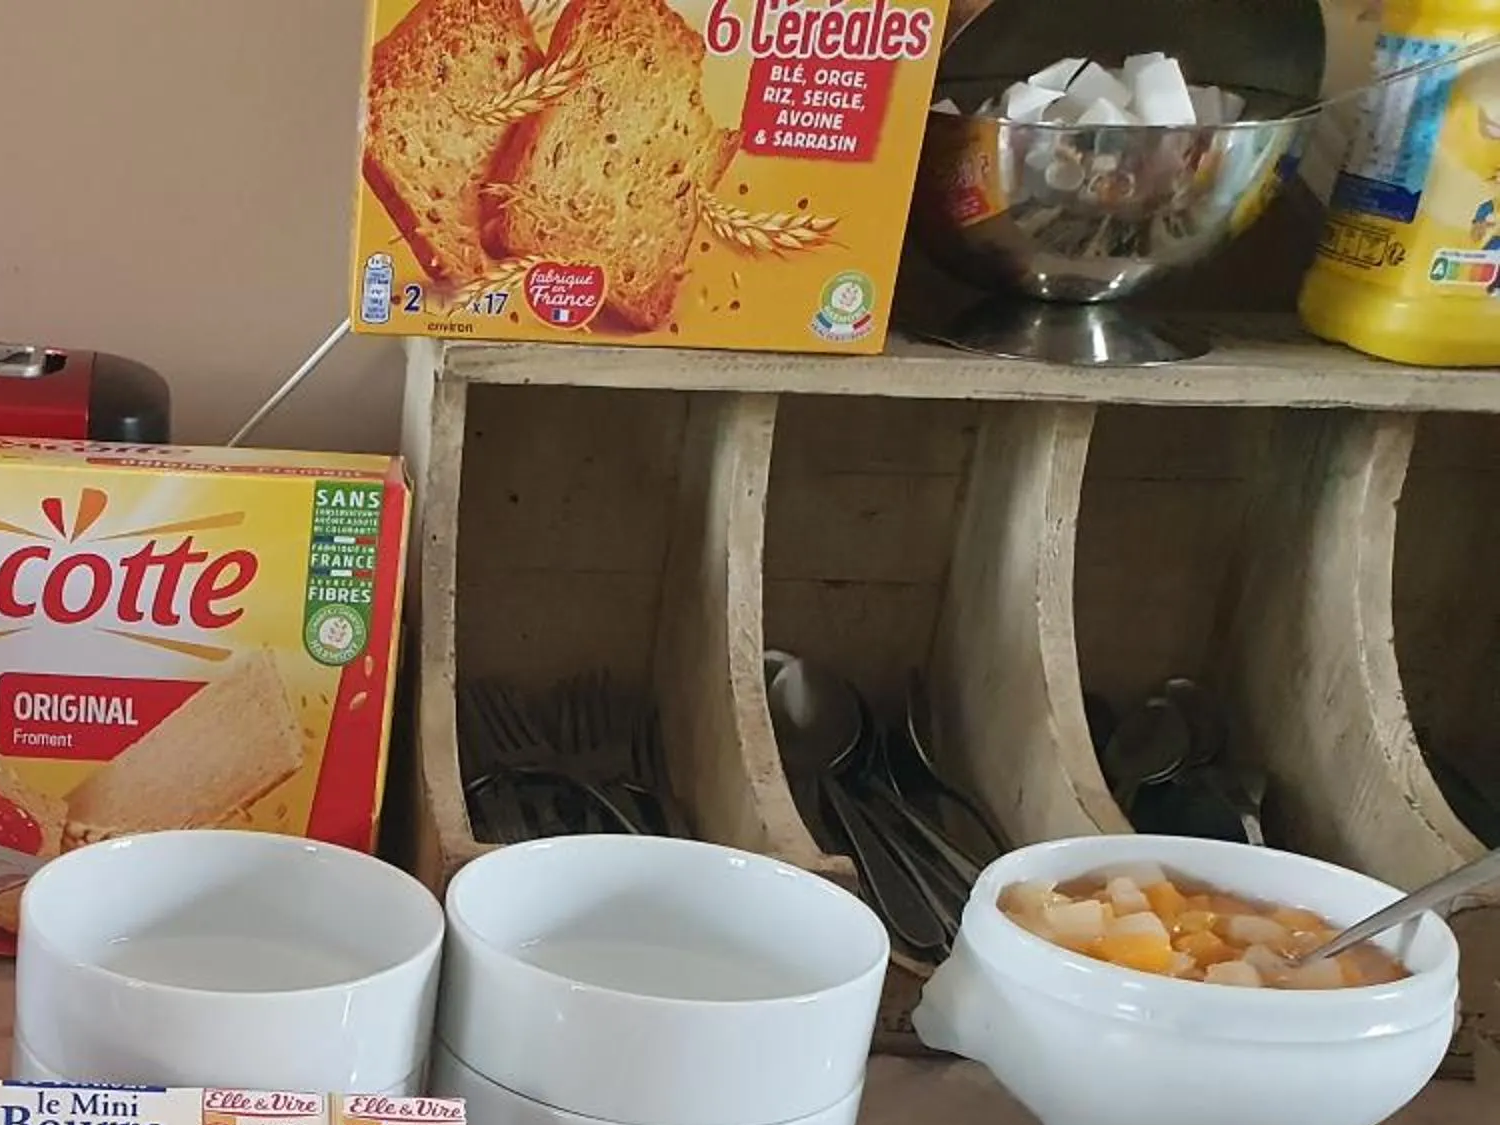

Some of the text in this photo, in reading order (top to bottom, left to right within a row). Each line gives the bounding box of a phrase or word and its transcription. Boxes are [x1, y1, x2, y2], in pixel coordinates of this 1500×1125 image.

[706, 0, 742, 54] 6
[770, 64, 868, 89] BLÉ, ORGE,
[763, 87, 866, 111] RIZ, SEIGLE,
[776, 110, 844, 130] AVOINE
[754, 130, 857, 152] & SARRASIN
[403, 284, 422, 314] 2
[529, 285, 597, 308] France
[316, 489, 380, 508] SANS
[311, 553, 374, 569] FRANCE
[308, 586, 371, 603] FIBRES
[13, 691, 139, 727] ORIGINAL
[13, 729, 73, 749] Froment
[37, 1090, 138, 1117] le Mini
[205, 1091, 254, 1111] Elle
[268, 1094, 318, 1112] Vire
[349, 1097, 397, 1114] Elle
[414, 1100, 464, 1119] Vire
